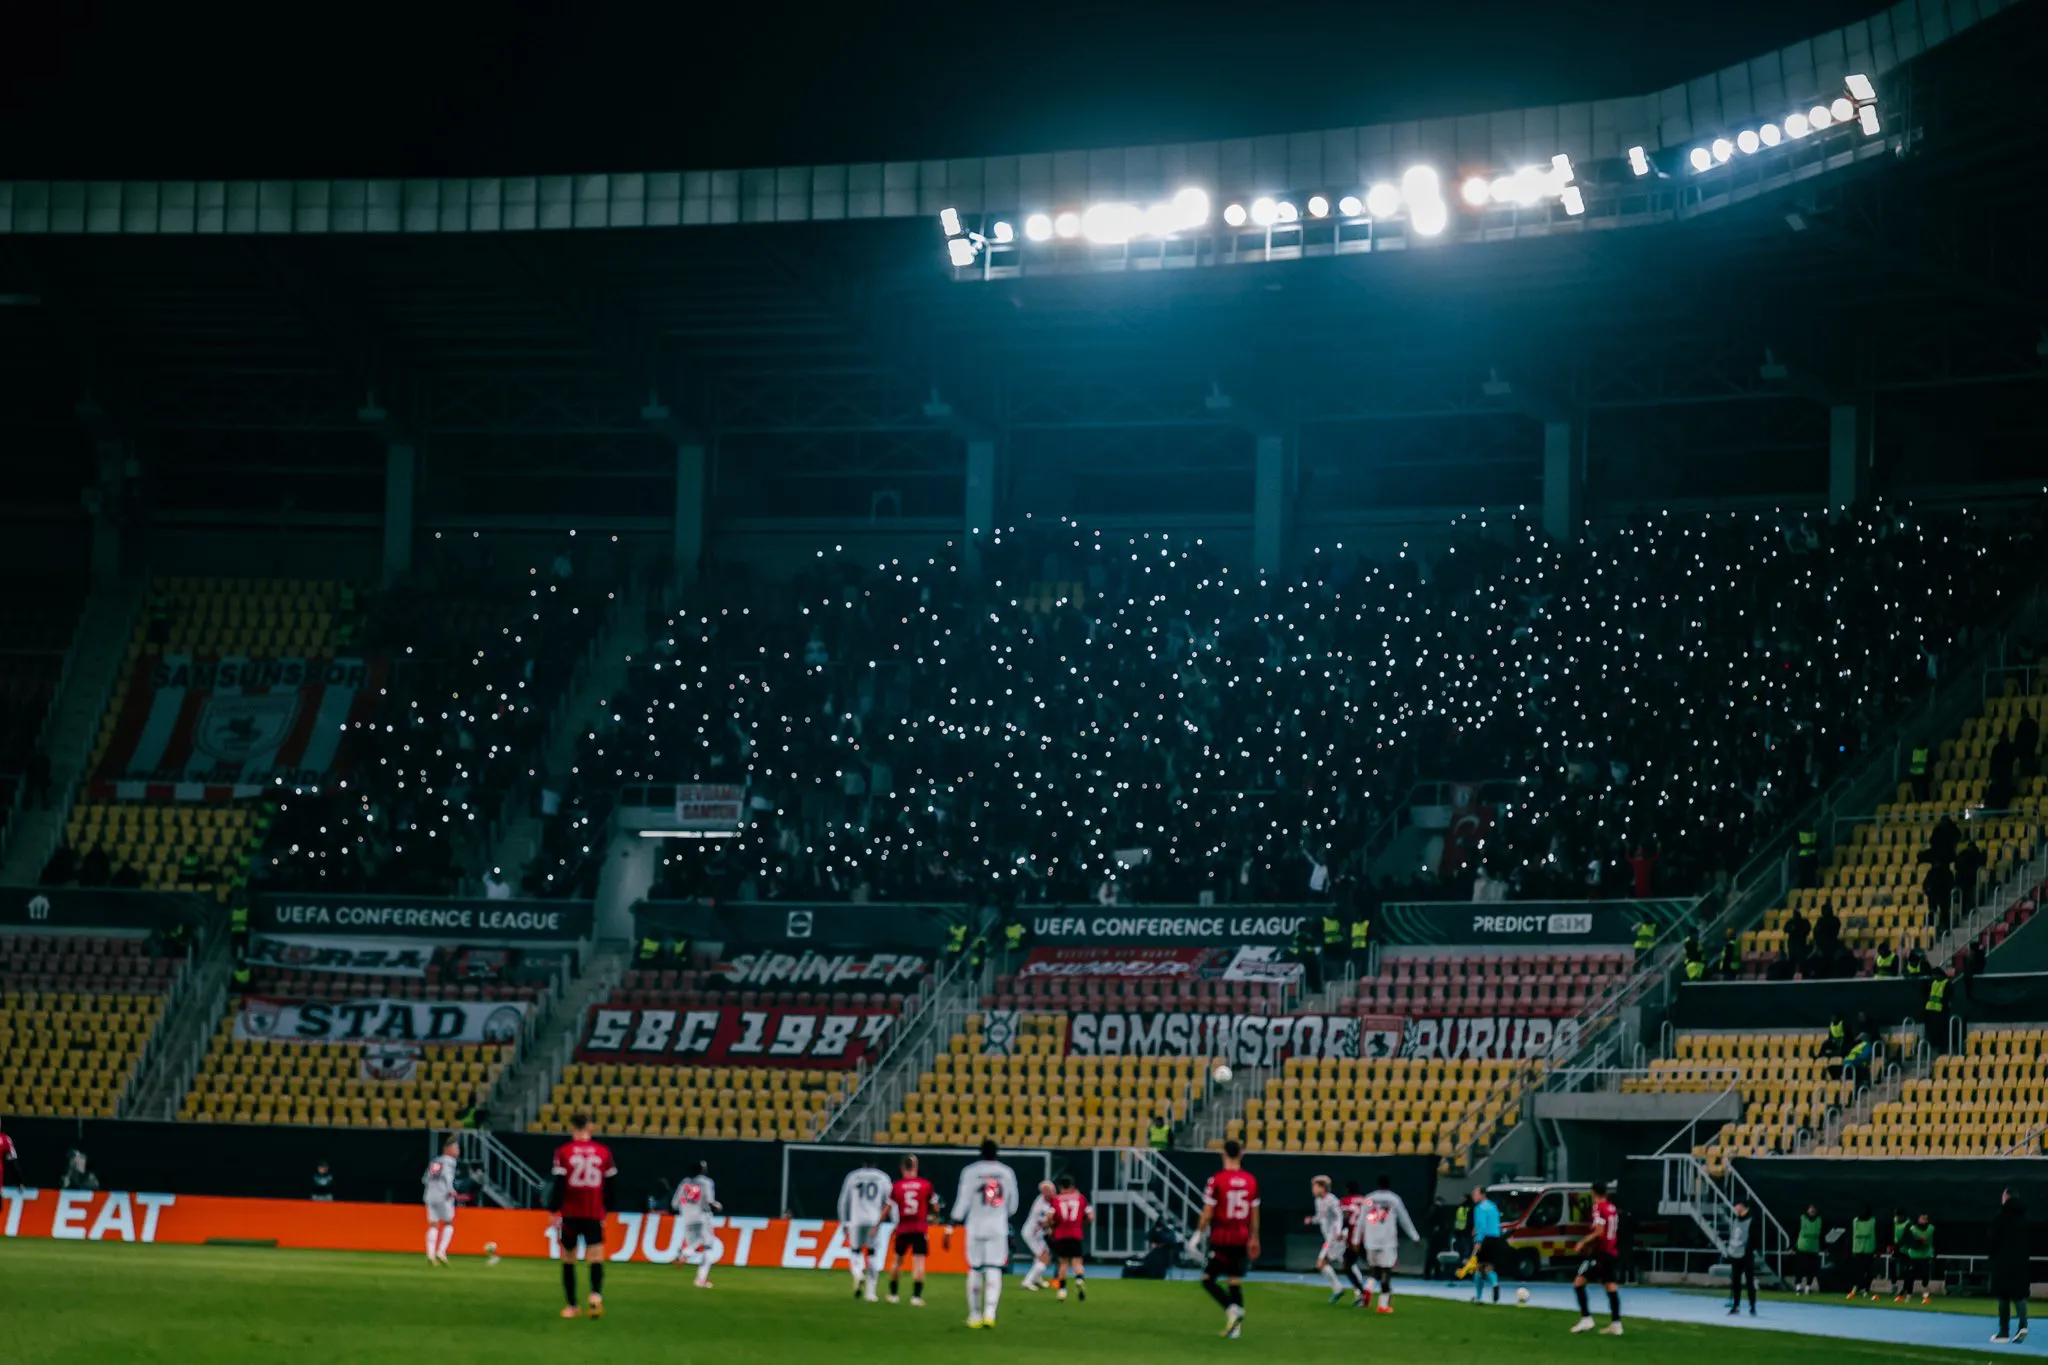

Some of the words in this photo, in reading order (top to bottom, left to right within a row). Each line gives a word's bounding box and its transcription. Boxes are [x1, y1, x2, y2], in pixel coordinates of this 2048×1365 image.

[152, 660, 369, 689] SAMSUNSPOR
[275, 905, 331, 925] UEFA
[335, 906, 473, 928] CONFERENCE
[478, 911, 560, 930] LEAGUE
[1033, 916, 1088, 937] UEFA
[1091, 916, 1225, 937] CONFERENCE
[1473, 915, 1546, 933] PREDICT
[296, 1003, 467, 1040] STAD
[585, 1008, 721, 1056] SBC
[567, 1154, 603, 1188] 26
[856, 1182, 878, 1201] 10
[903, 1190, 920, 1216] 5
[1226, 1189, 1250, 1220] 15
[51, 1189, 176, 1242] EAT
[1059, 1194, 1081, 1222] 17
